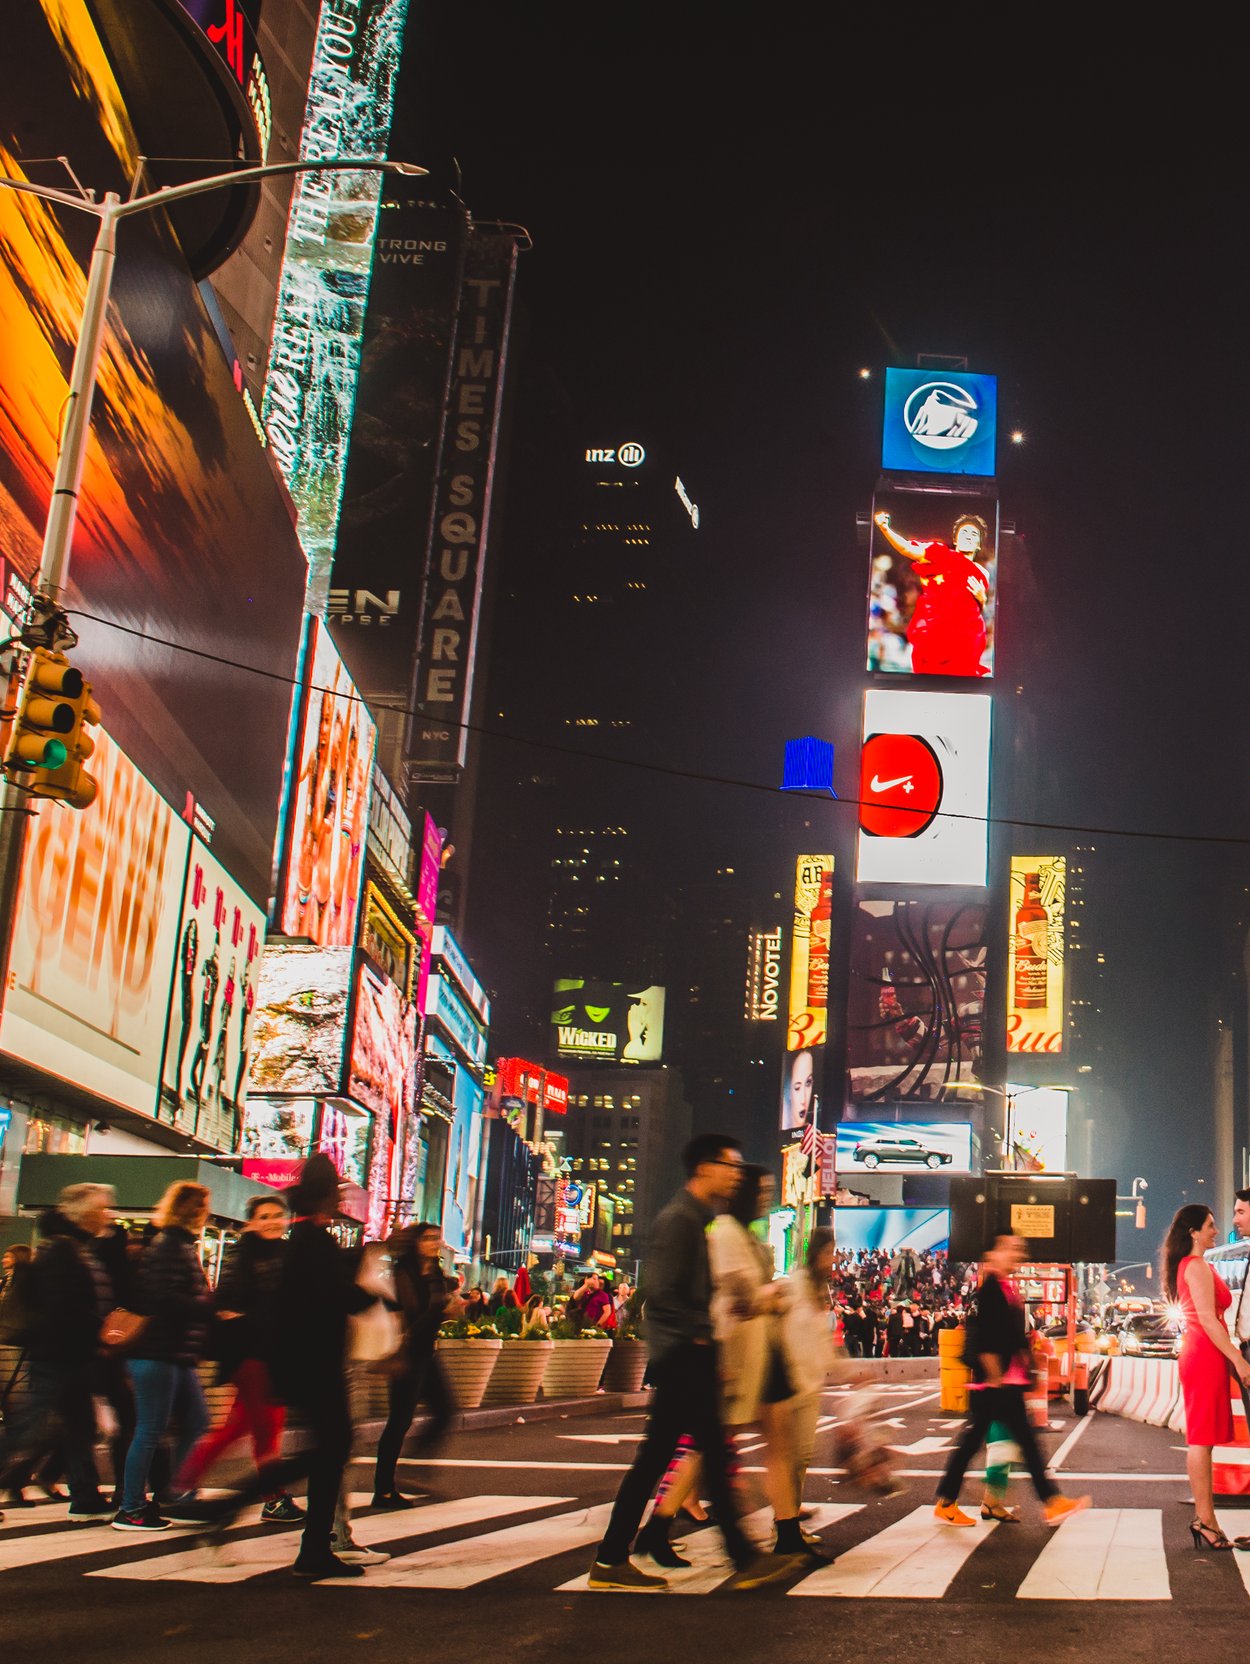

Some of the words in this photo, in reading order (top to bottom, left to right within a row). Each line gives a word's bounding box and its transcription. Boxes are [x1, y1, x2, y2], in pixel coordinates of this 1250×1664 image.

[320, 10, 358, 80] YOU
[305, 88, 348, 161] REAL
[291, 176, 334, 247] THE
[455, 278, 501, 453] TIMES
[426, 474, 477, 702] SQUARE
[422, 731, 449, 741] NYC
[759, 925, 783, 1022] NOVOTEL
